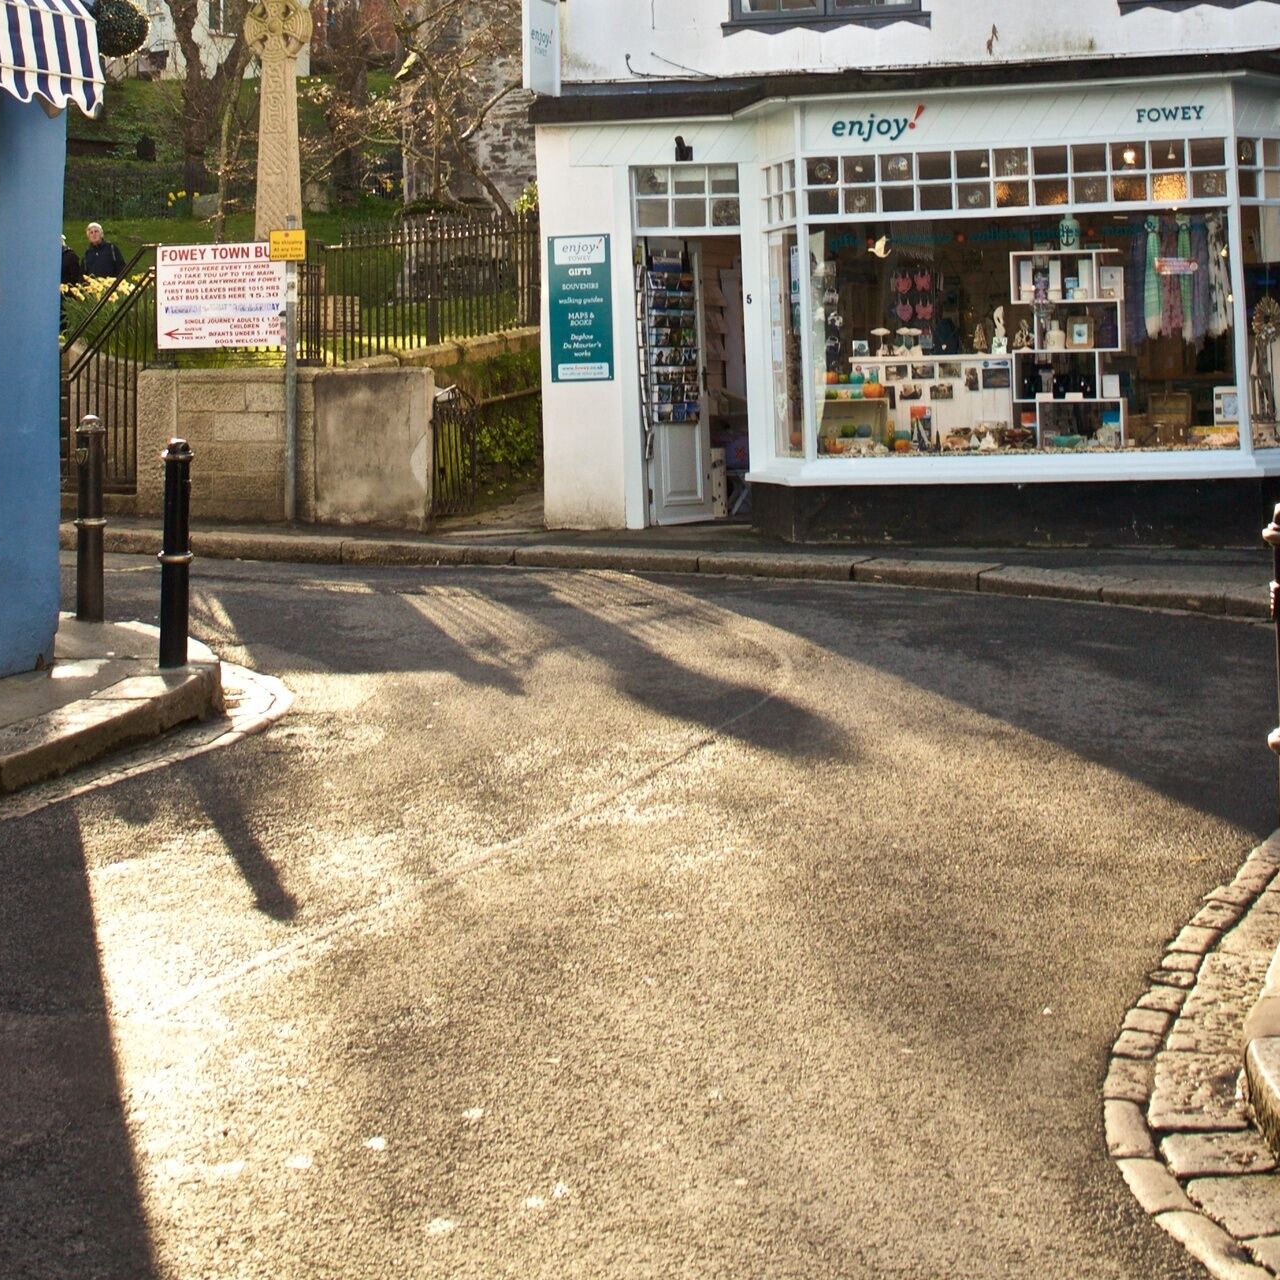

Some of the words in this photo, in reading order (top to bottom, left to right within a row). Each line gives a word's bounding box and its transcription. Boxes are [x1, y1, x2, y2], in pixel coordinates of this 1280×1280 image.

[1135, 105, 1204, 123] FOWEY
[832, 103, 924, 142] enjoy!
[161, 248, 206, 262] FOWEY
[211, 246, 249, 260] TOWN
[568, 267, 592, 276] GIFTS
[562, 282, 599, 290] SOUVENIRS
[558, 297, 582, 305] walking
[583, 296, 604, 304] guides
[746, 294, 752, 304] 5
[568, 312, 588, 320] MAPS
[570, 333, 594, 341] Daphne
